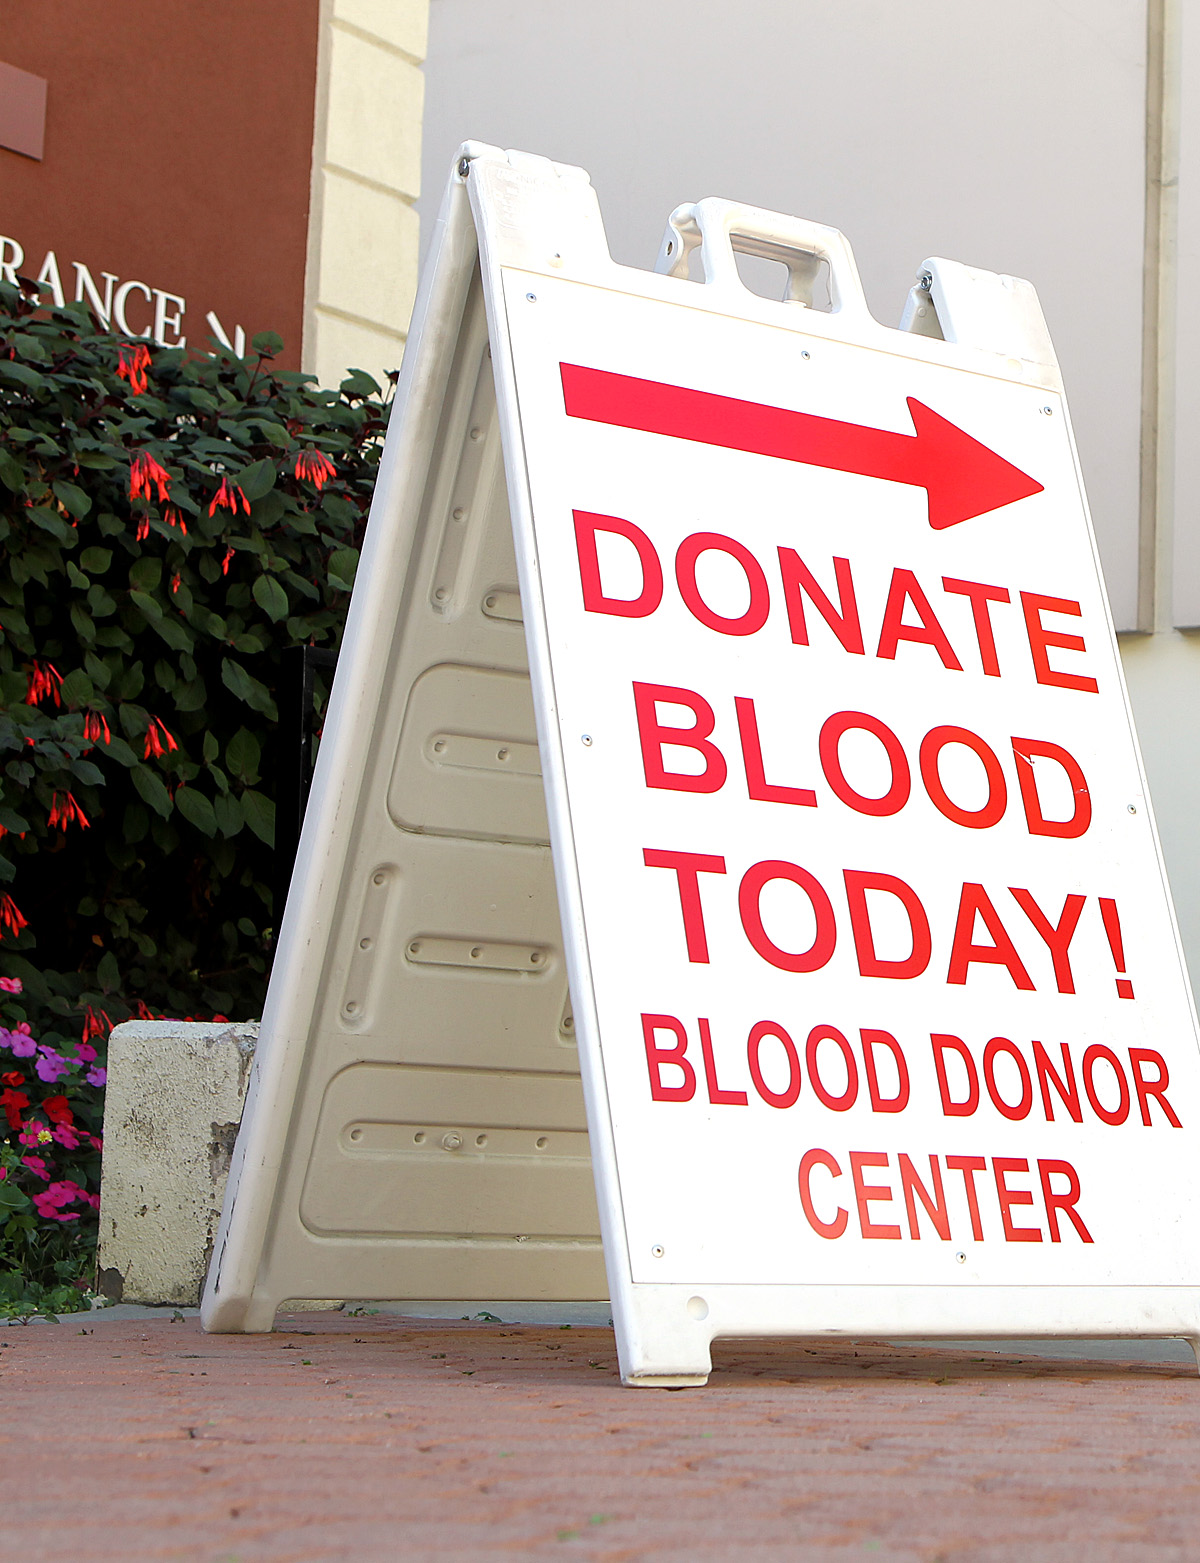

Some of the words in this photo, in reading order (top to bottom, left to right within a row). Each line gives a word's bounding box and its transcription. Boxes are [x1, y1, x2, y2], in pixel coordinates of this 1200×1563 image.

[573, 509, 1099, 694] DONATE
[633, 681, 1092, 839] BLOOD
[643, 848, 1134, 1000] TODAY!
[641, 1013, 911, 1114] BLOOD
[931, 1033, 1184, 1129] DONOR
[798, 1148, 1094, 1244] CENTER
